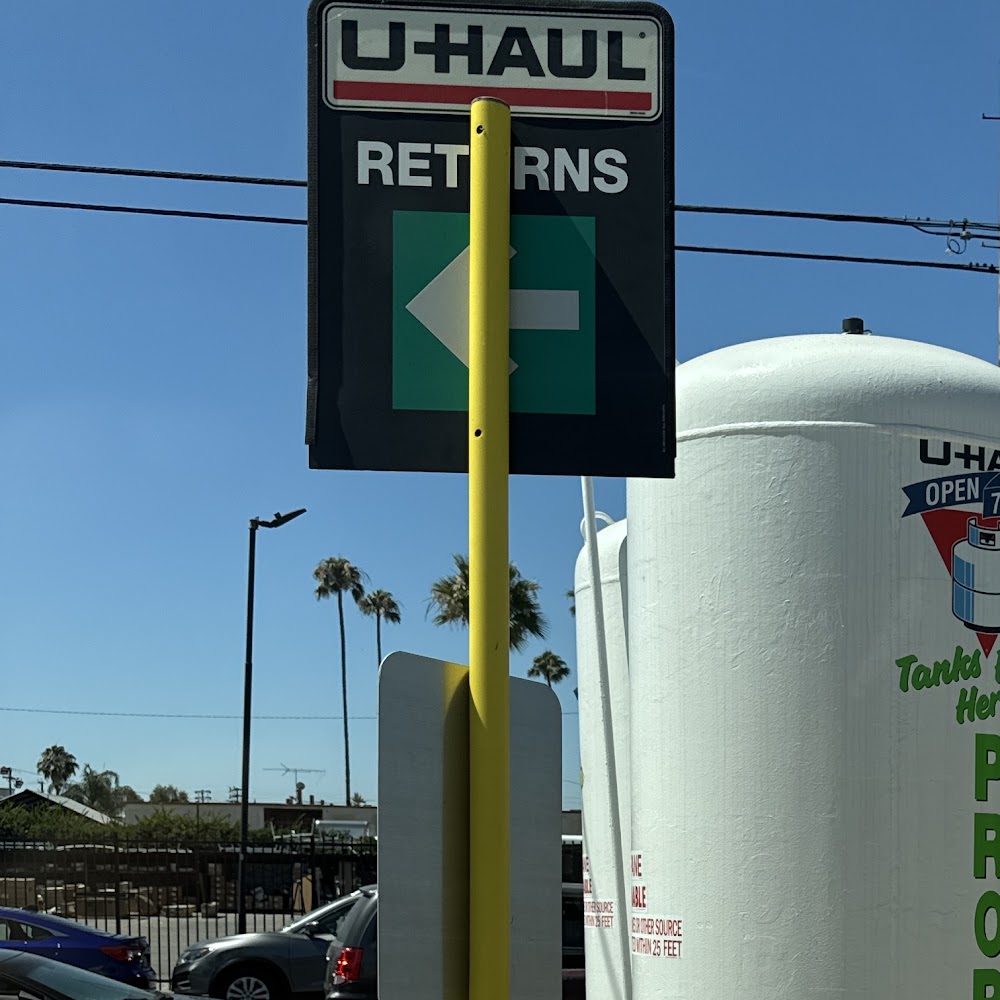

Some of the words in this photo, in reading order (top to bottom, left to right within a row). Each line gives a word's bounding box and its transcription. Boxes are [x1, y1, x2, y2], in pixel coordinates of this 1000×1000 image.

[341, 19, 646, 81] U-HAUL
[357, 140, 629, 194] RETRNS
[925, 477, 980, 506] OPEN
[991, 492, 1000, 514] 7
[895, 646, 982, 692] Tanks
[652, 939, 661, 956] 25
[663, 939, 682, 957] FEET
[655, 919, 682, 937] SOURCE
